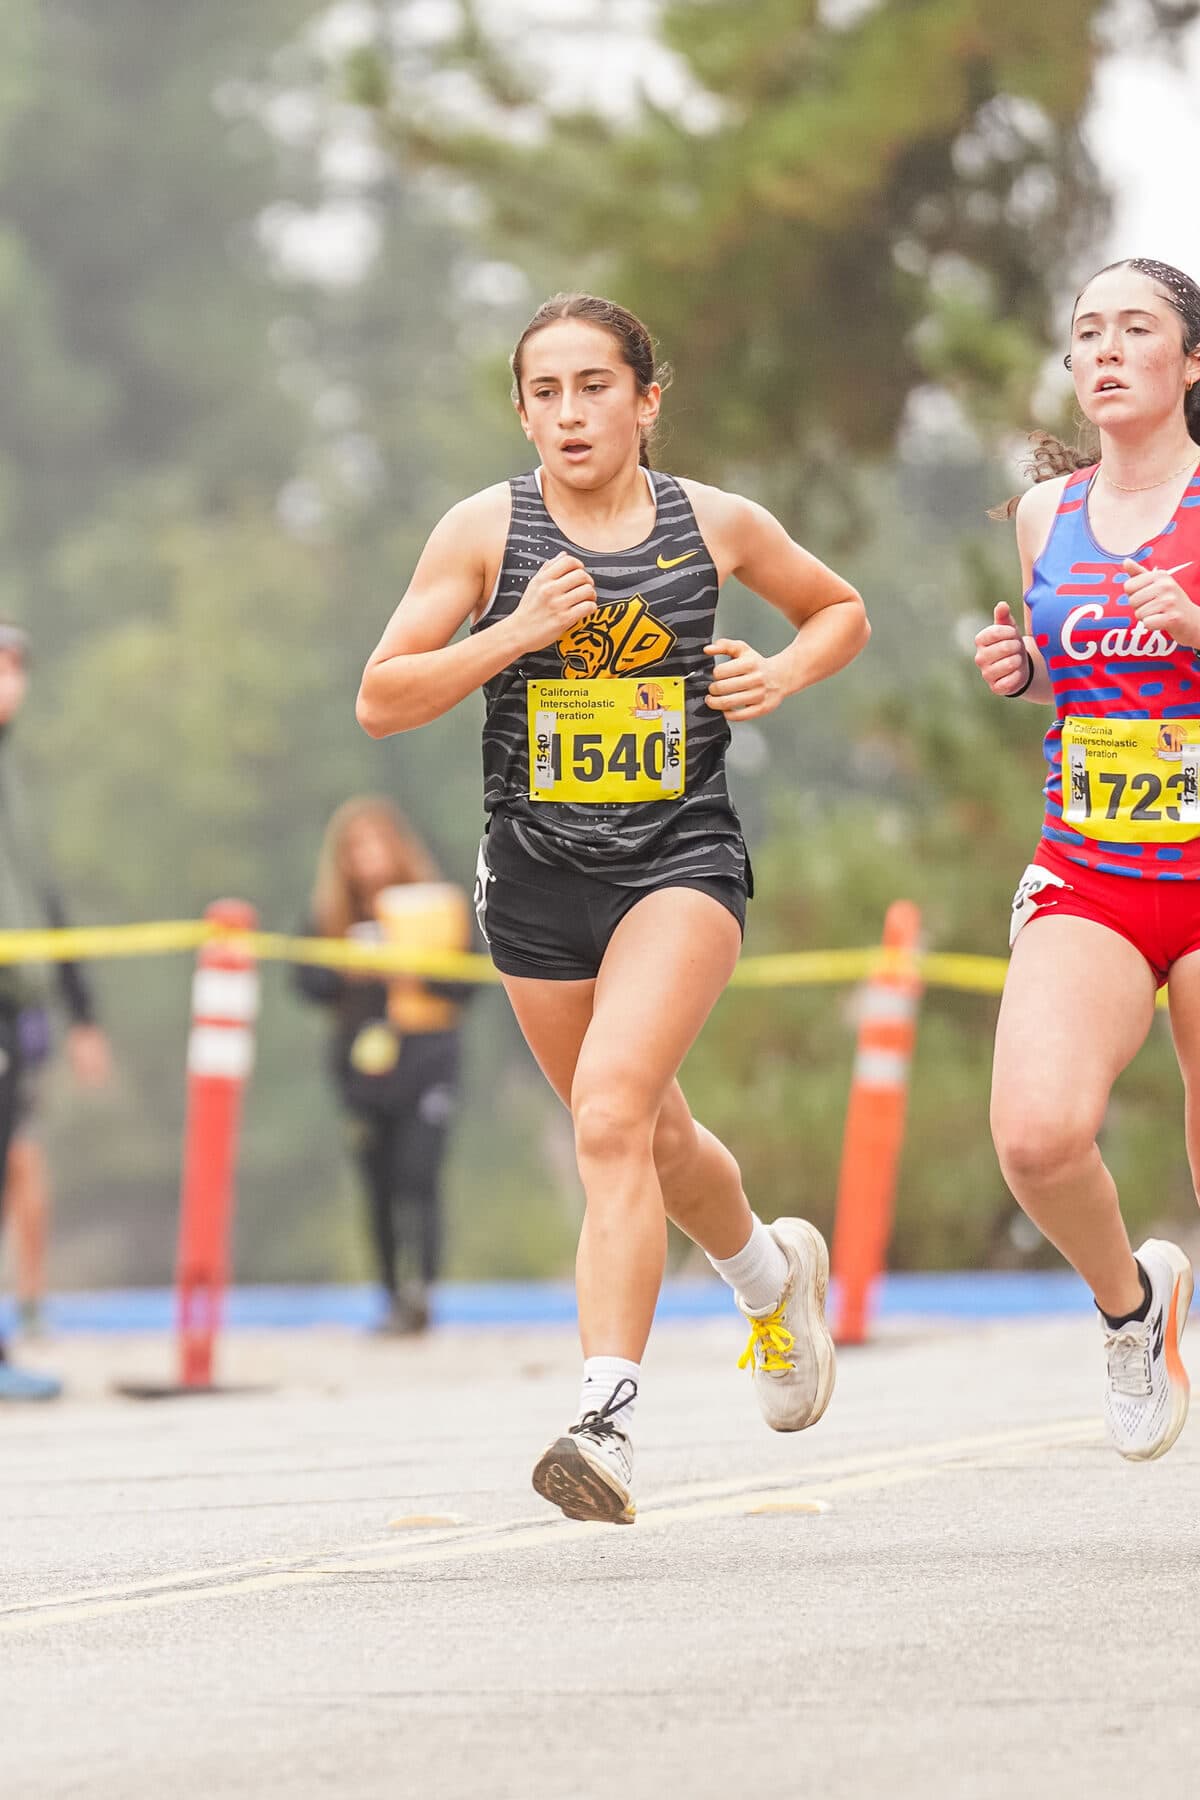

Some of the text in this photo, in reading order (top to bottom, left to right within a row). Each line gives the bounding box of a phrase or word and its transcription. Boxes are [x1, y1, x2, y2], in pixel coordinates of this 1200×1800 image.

[1061, 603, 1177, 660] Cats
[540, 687, 589, 697] California
[540, 699, 615, 708] Interscholastic
[555, 711, 595, 720] eration
[1073, 724, 1113, 736] California
[1071, 735, 1138, 748] Interscholastic
[537, 734, 549, 772] 1540
[669, 728, 680, 768] 1540
[1085, 748, 1118, 759] eration
[551, 732, 666, 782] 1540
